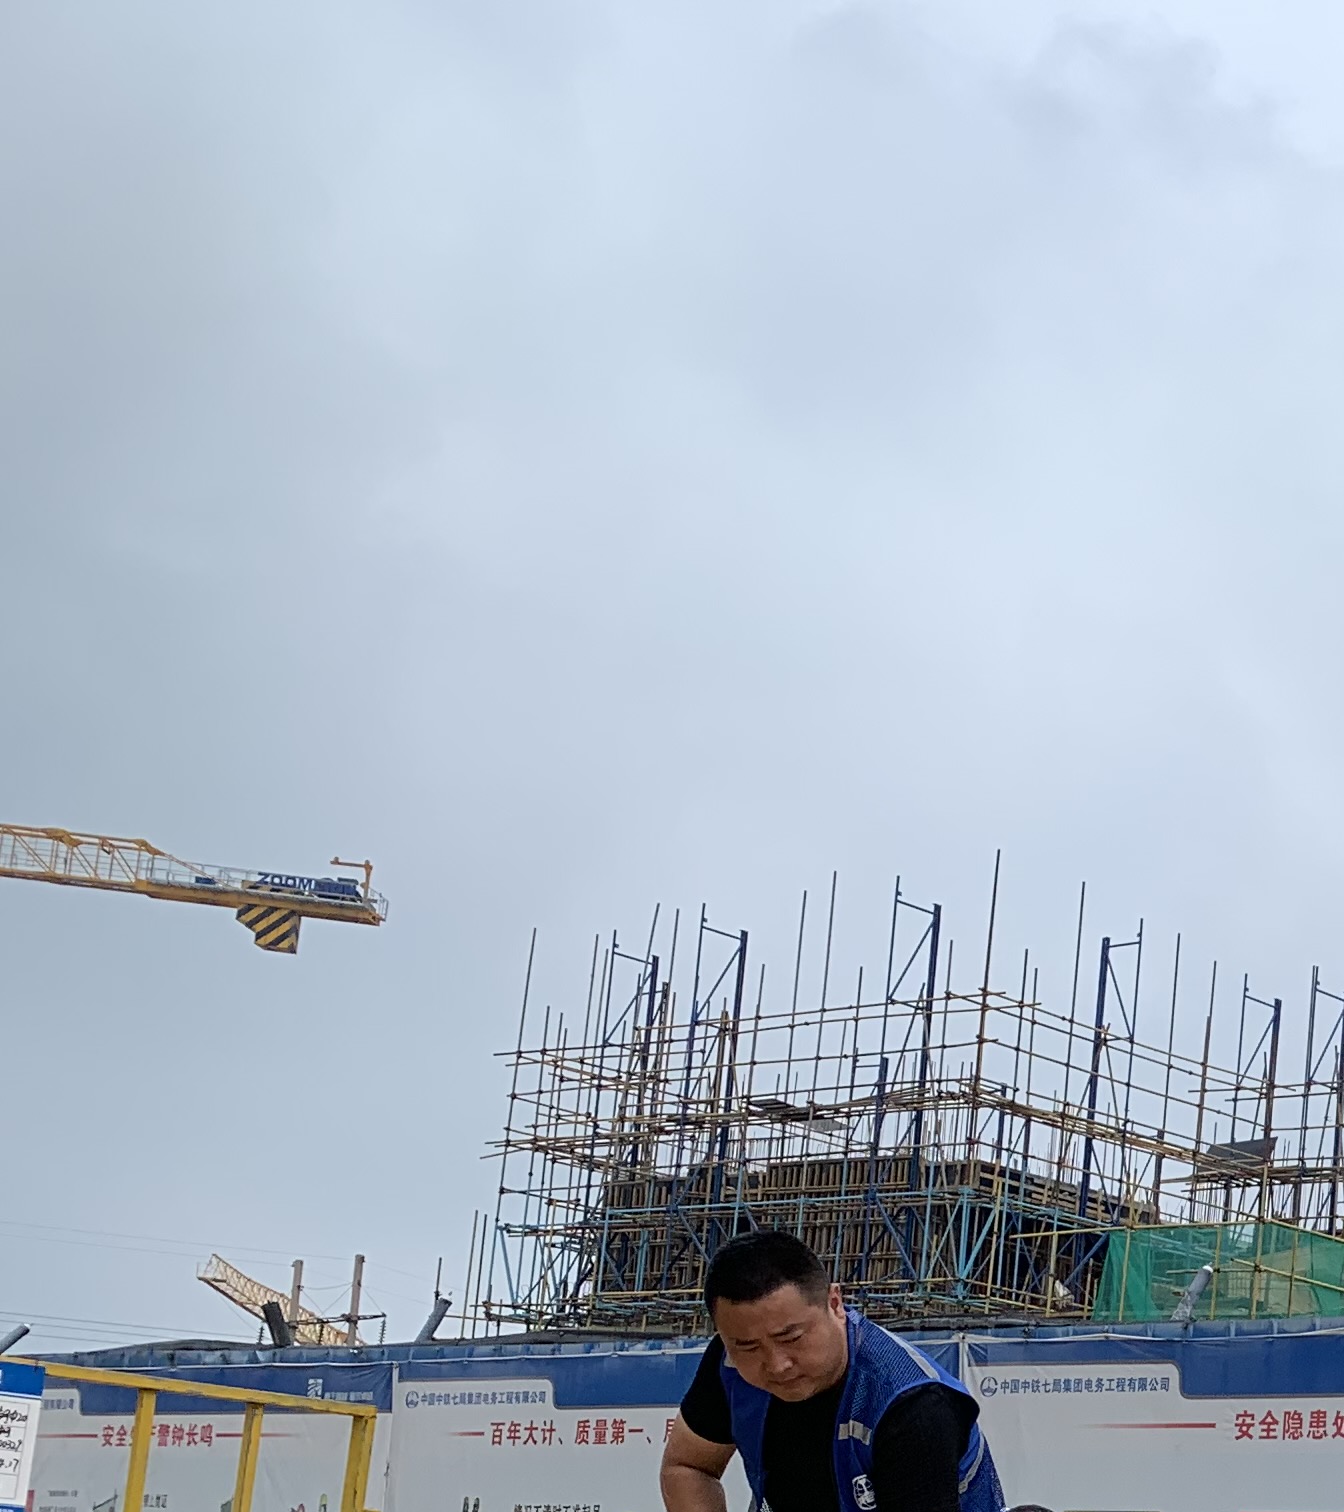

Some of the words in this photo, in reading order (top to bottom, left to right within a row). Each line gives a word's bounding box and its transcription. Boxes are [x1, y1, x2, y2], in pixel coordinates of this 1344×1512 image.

[1000, 1376, 1171, 1395] 中国中铁七局集团电务工程有限公司
